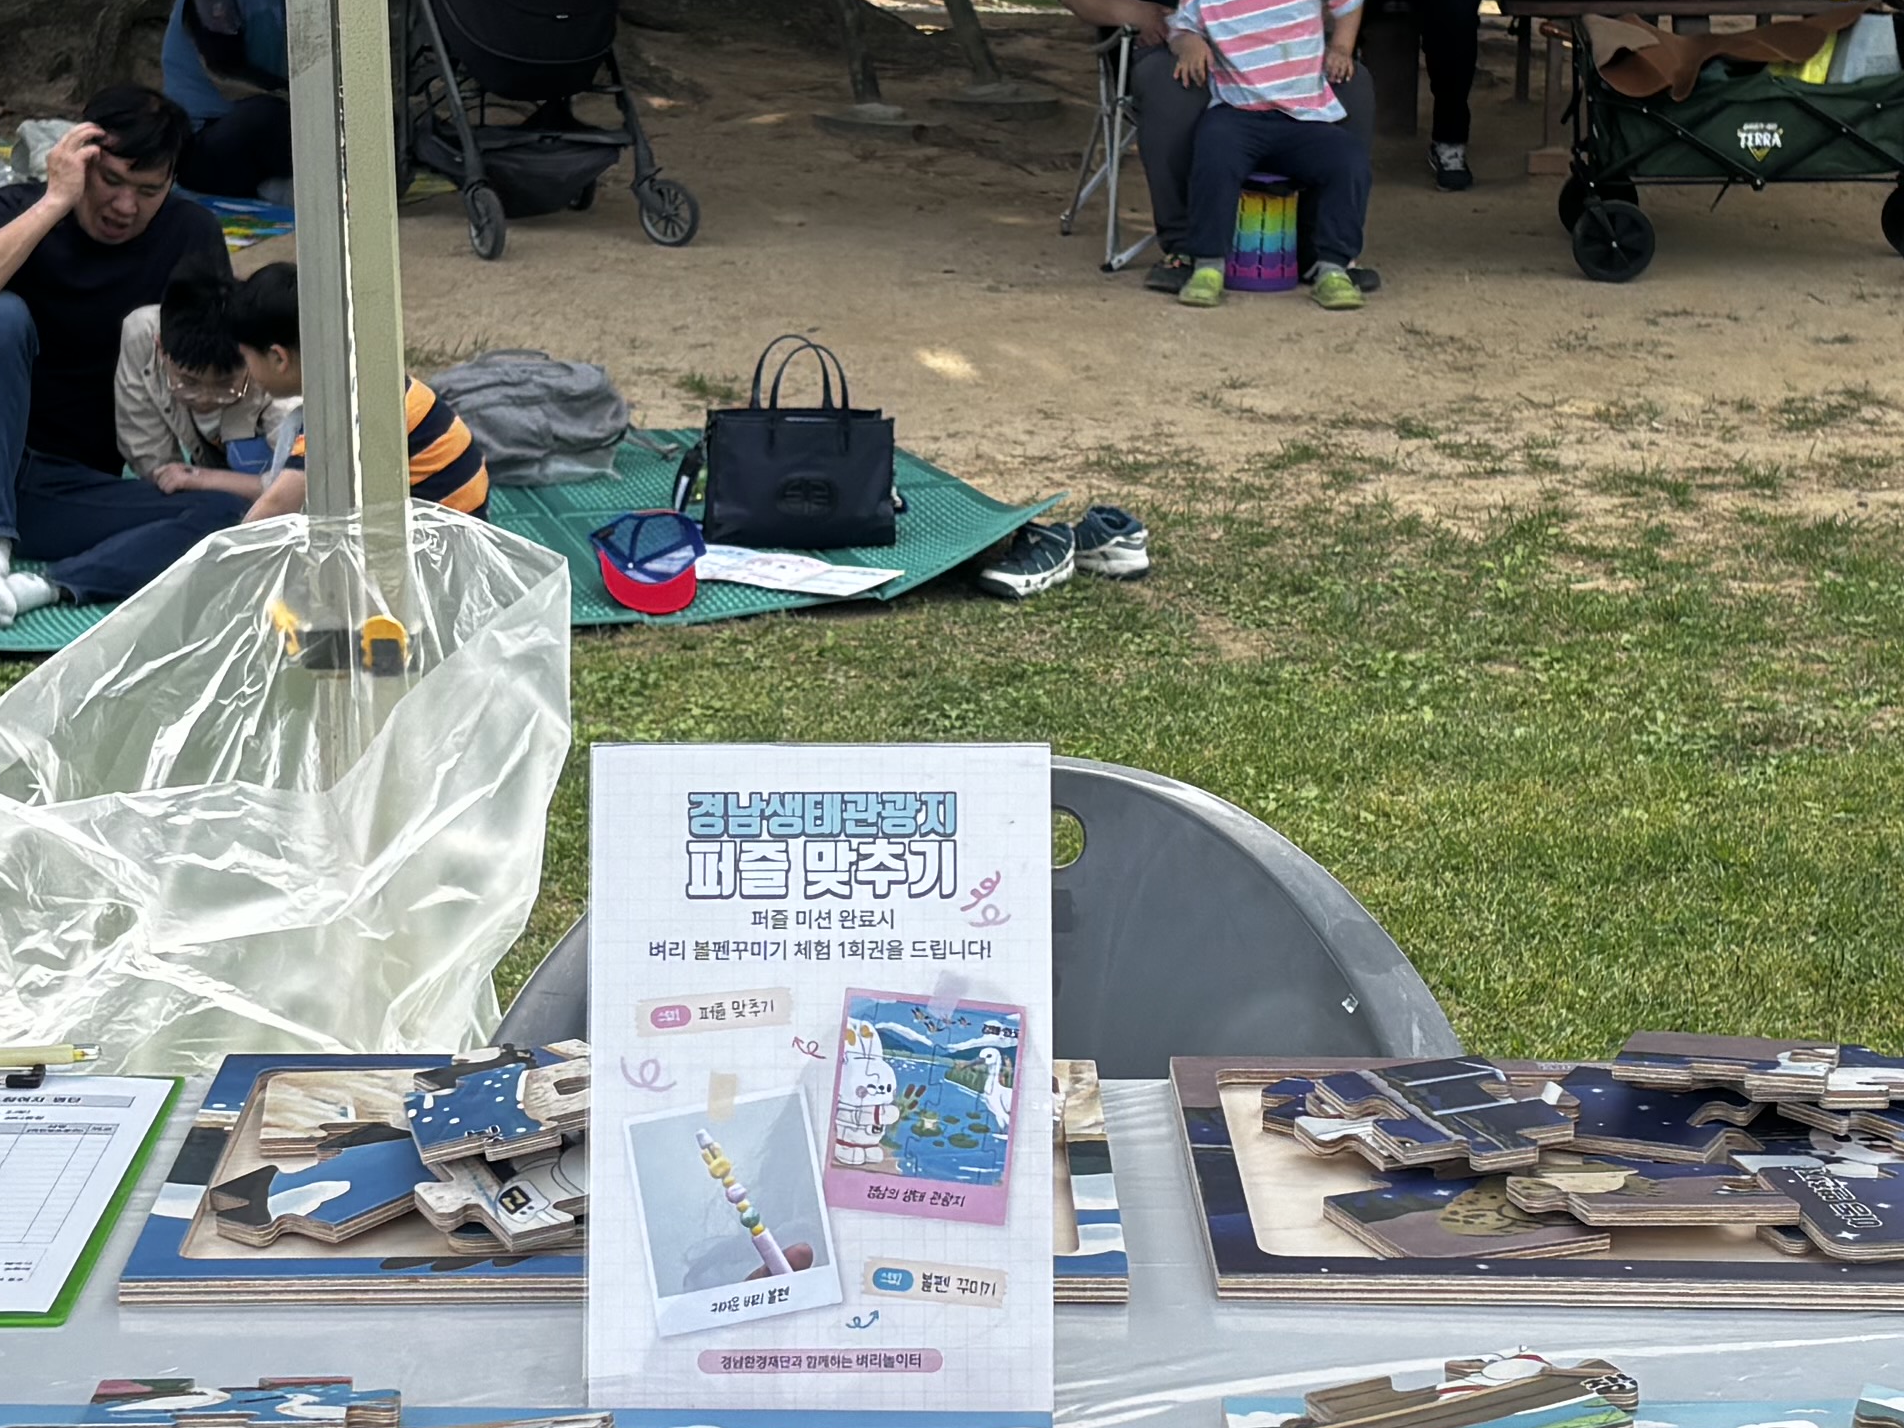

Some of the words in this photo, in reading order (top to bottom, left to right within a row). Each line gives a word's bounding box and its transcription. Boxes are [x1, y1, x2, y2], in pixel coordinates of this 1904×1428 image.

[1737, 128, 1784, 149] TERRA
[687, 792, 957, 838] 경남생태관광지
[686, 839, 791, 899] 퍼즐
[803, 839, 957, 899] 맞추기
[751, 909, 789, 930] 퍼즐
[795, 909, 833, 930] 미션
[838, 909, 895, 930] 완료시
[648, 939, 686, 962] 벼리
[692, 940, 787, 961] 볼펜꾸미기
[793, 940, 831, 961] 체험
[838, 940, 904, 961] 1회권을
[910, 938, 992, 961] 드립니다!
[699, 1002, 726, 1020] 퍼즐
[731, 999, 774, 1018] 맞추기
[867, 1185, 899, 1200] 경남의
[929, 1191, 966, 1208] 관광지
[767, 1286, 790, 1304] 볼펜
[921, 1272, 950, 1293] 볼펜
[956, 1277, 996, 1296] 꾸미기
[720, 1355, 802, 1370] 경남환경재단과
[806, 1354, 853, 1370] 함께하는
[856, 1352, 922, 1370] 벼리놀이터
